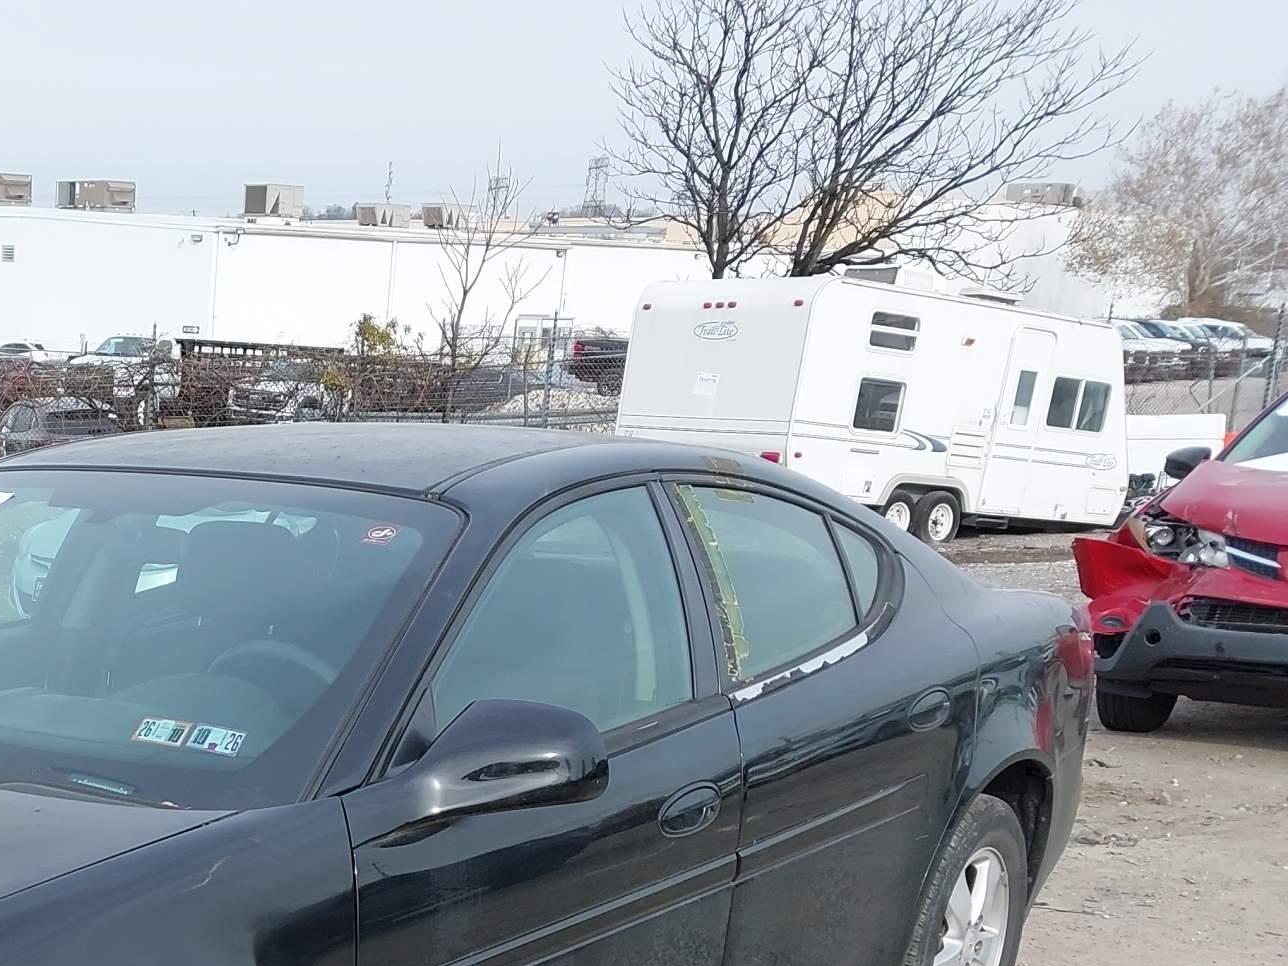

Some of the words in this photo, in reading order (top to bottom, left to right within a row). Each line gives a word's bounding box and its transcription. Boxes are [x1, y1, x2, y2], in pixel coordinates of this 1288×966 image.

[138, 720, 156, 738] 26
[168, 727, 185, 743] 10
[192, 727, 211, 745] 10
[224, 733, 242, 752] 26
